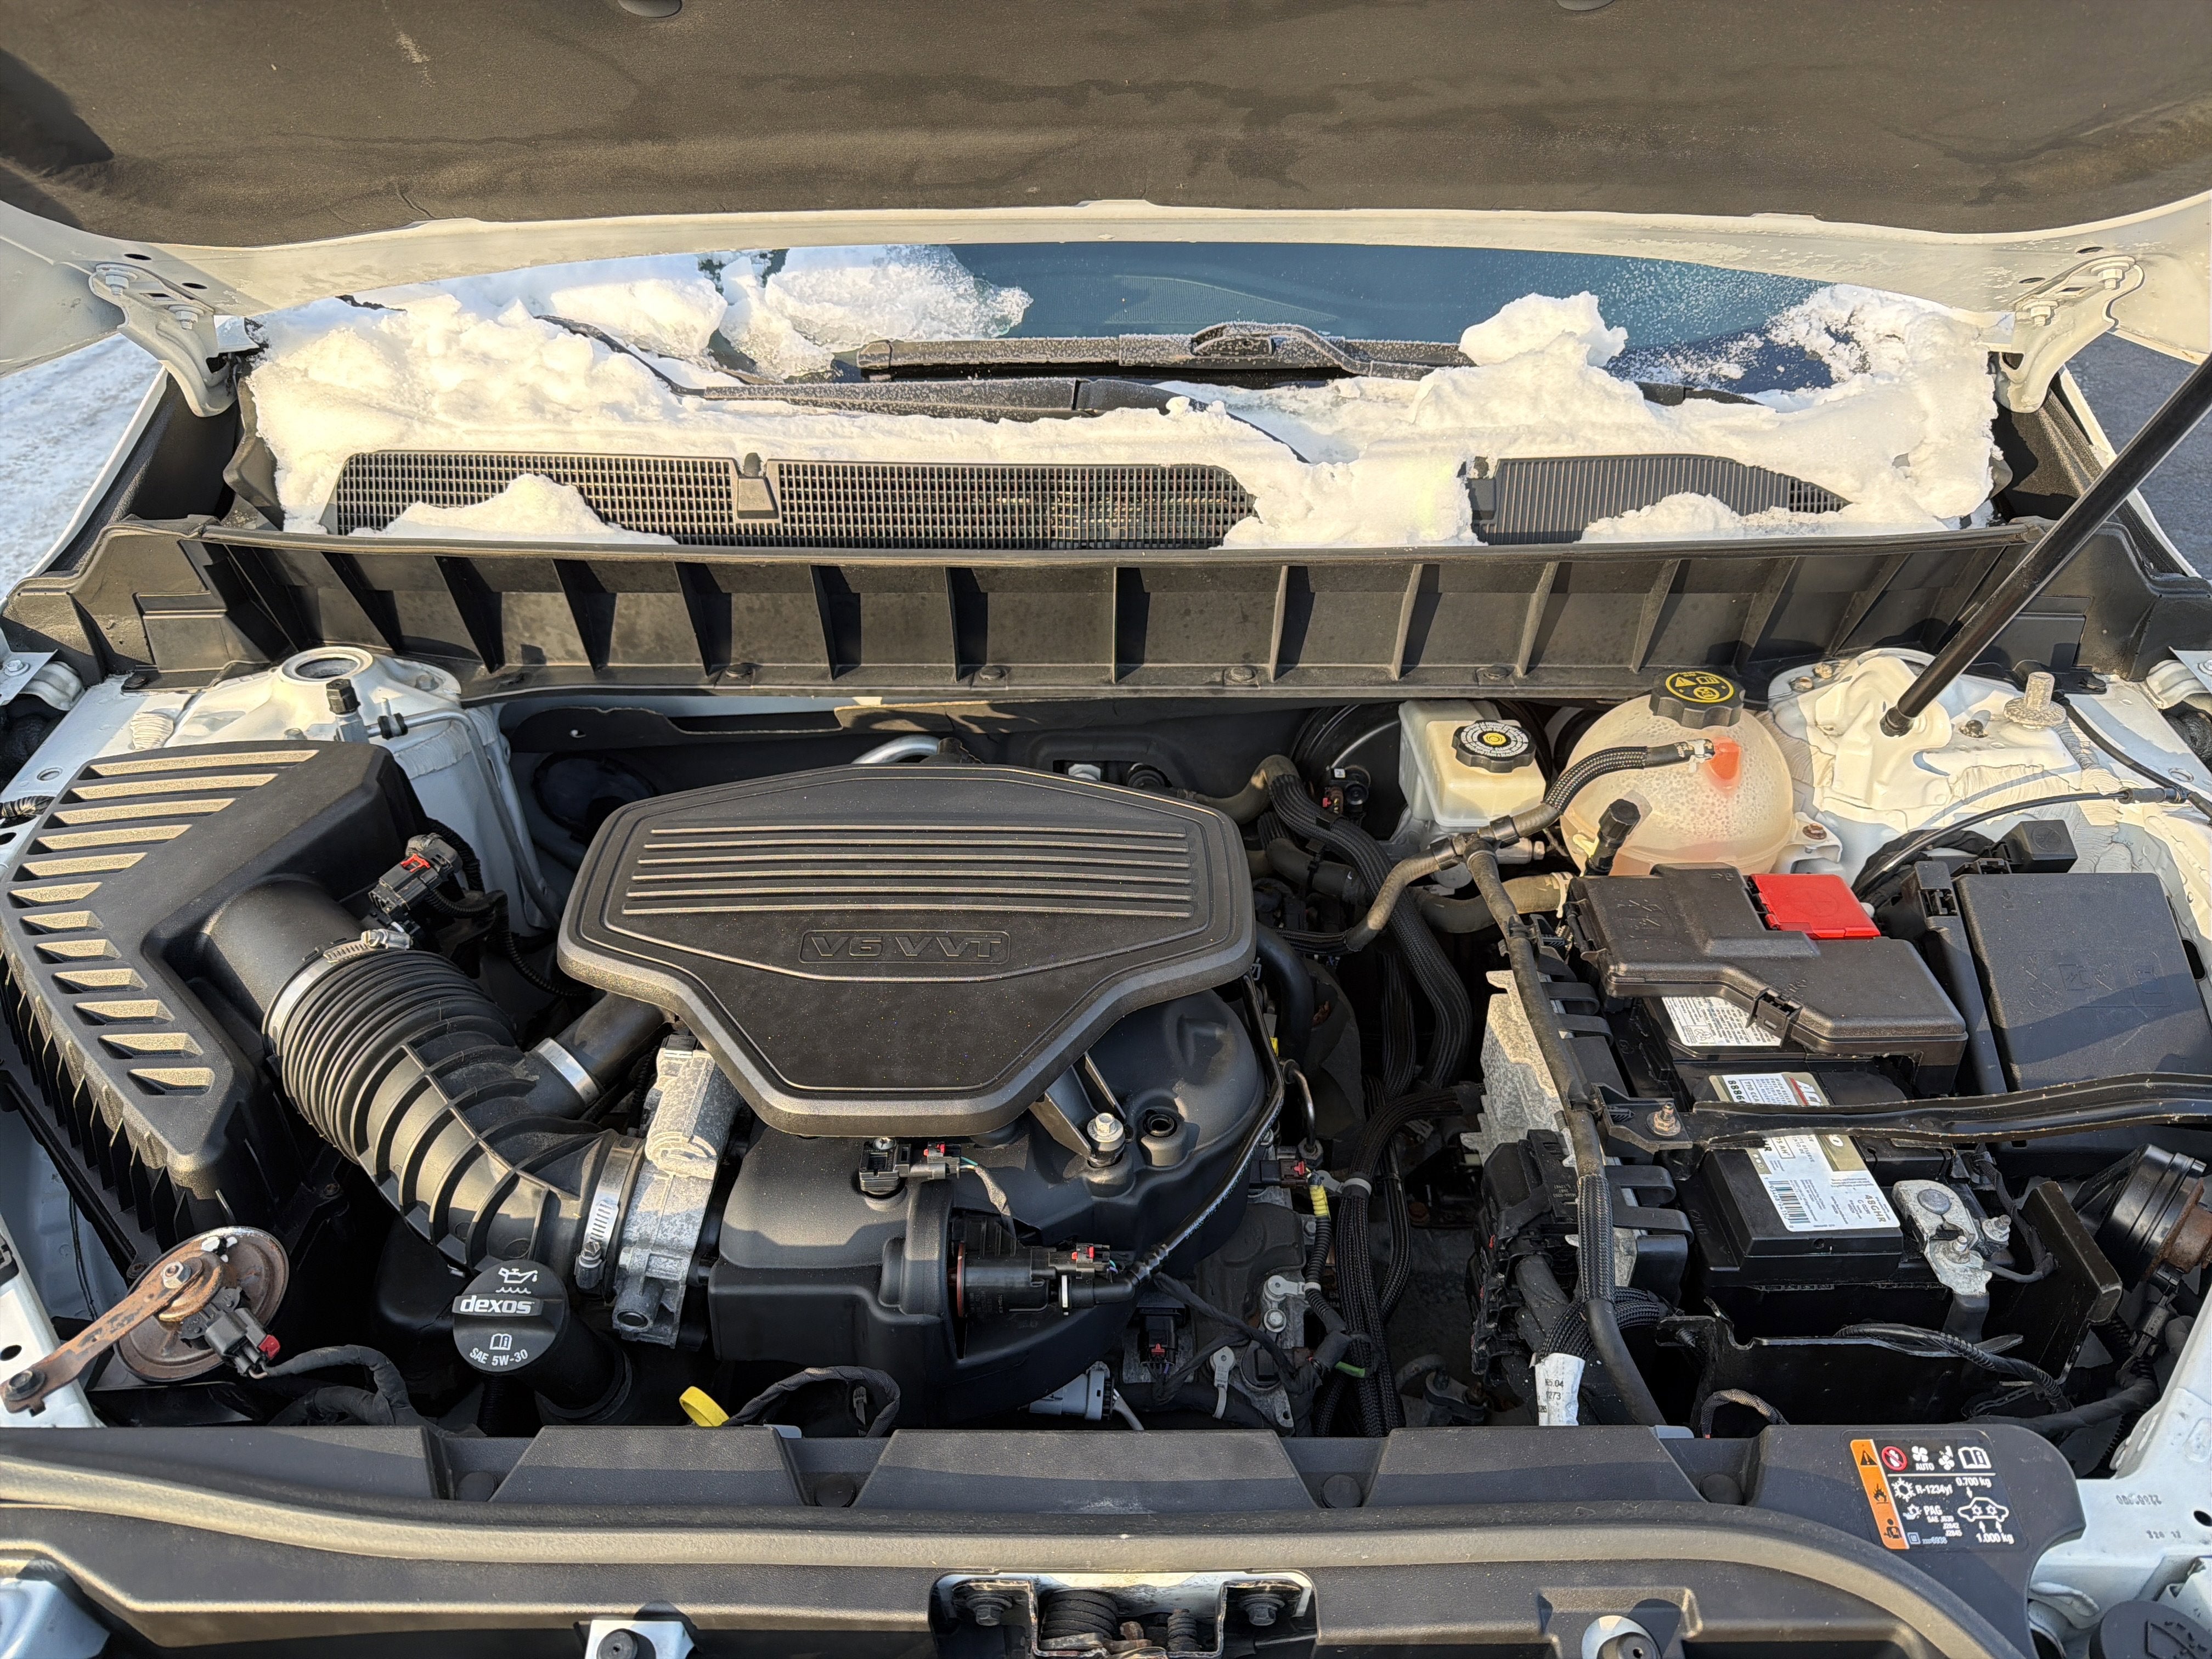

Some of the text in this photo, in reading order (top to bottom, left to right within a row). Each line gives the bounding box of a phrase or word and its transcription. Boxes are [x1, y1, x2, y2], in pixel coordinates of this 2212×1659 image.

[811, 936, 1002, 957] V6 VVT
[1743, 1081, 1760, 1102] 770 CCA
[1863, 1194, 1887, 1222] 48GHR
[469, 1347, 528, 1366] SAE 5W-30
[1916, 1463, 1935, 1471] AUTO
[1955, 1477, 1992, 1488] 0.700 kg
[1915, 1484, 1953, 1496] R-1234yf
[1923, 1505, 1943, 1516] PAG
[1976, 1533, 2015, 1544] 1.000 kg
